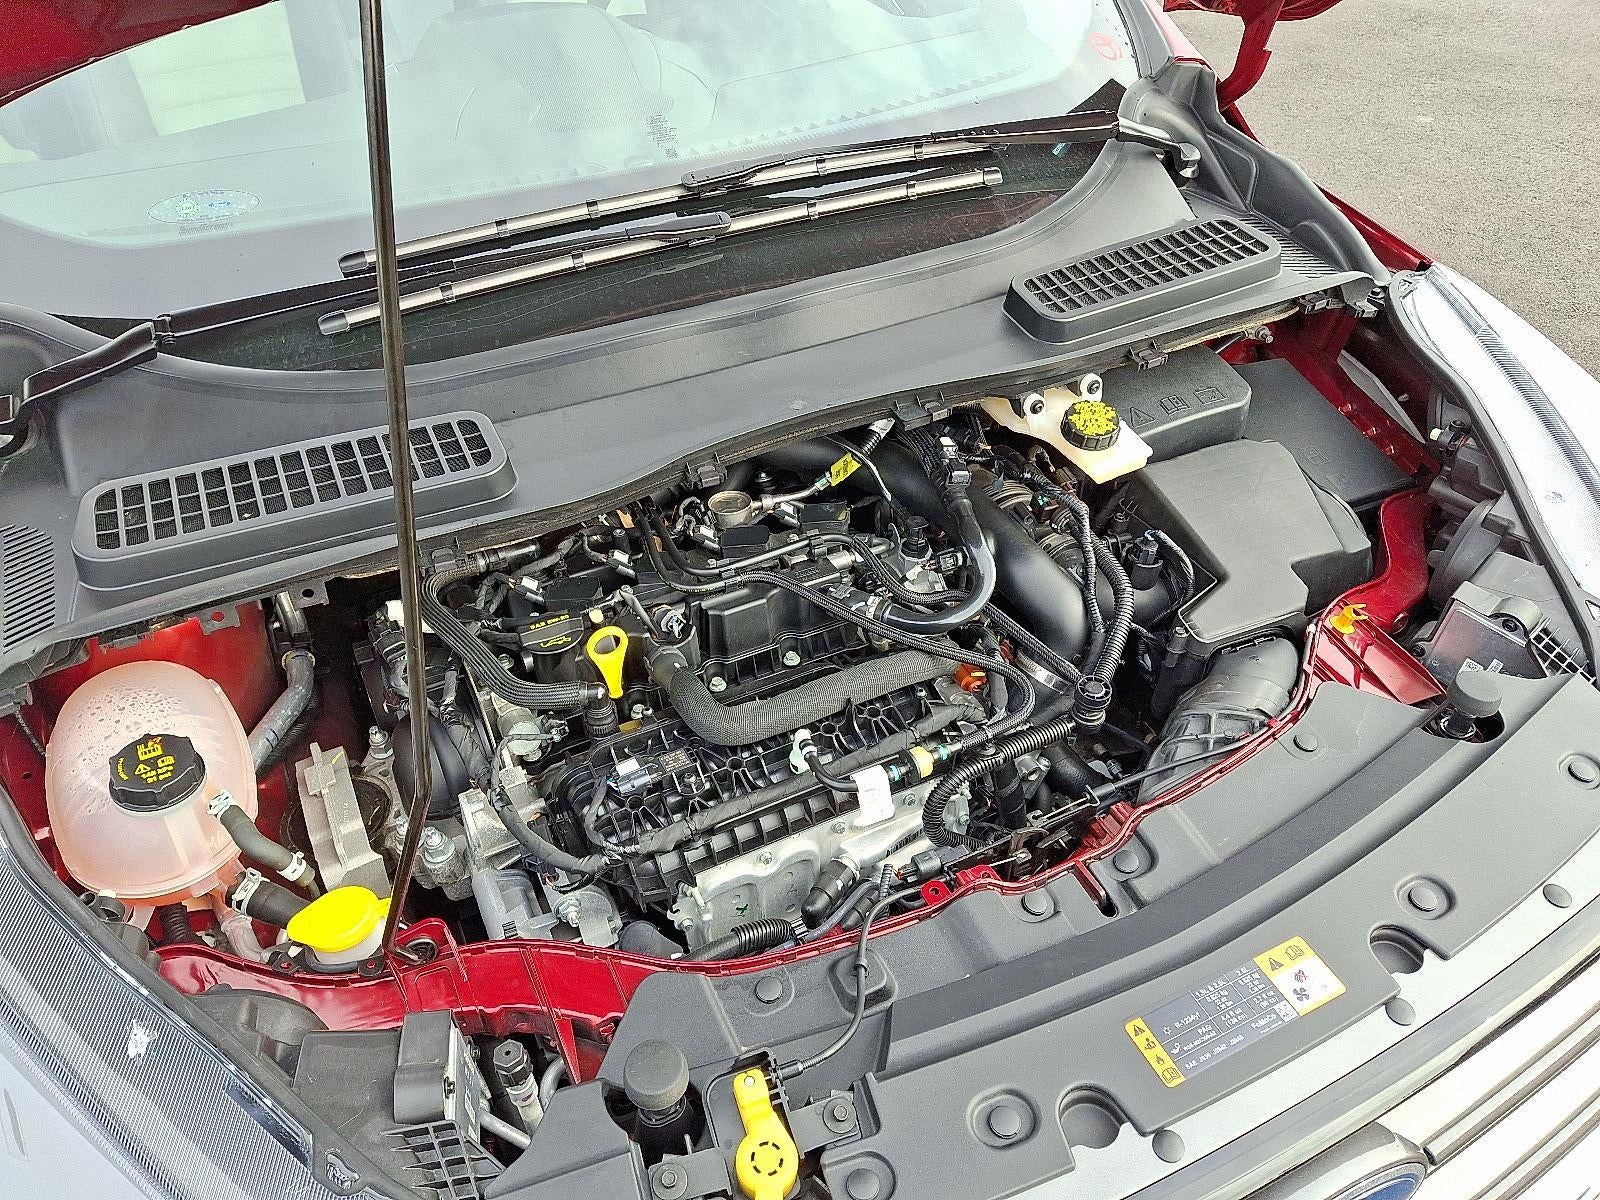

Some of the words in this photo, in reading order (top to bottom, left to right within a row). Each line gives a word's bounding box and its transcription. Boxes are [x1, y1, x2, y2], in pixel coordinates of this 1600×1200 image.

[1250, 1013, 1277, 1029] FoMoCo
[1197, 1024, 1213, 1035] PAG
[1185, 1059, 1199, 1070] SAE
